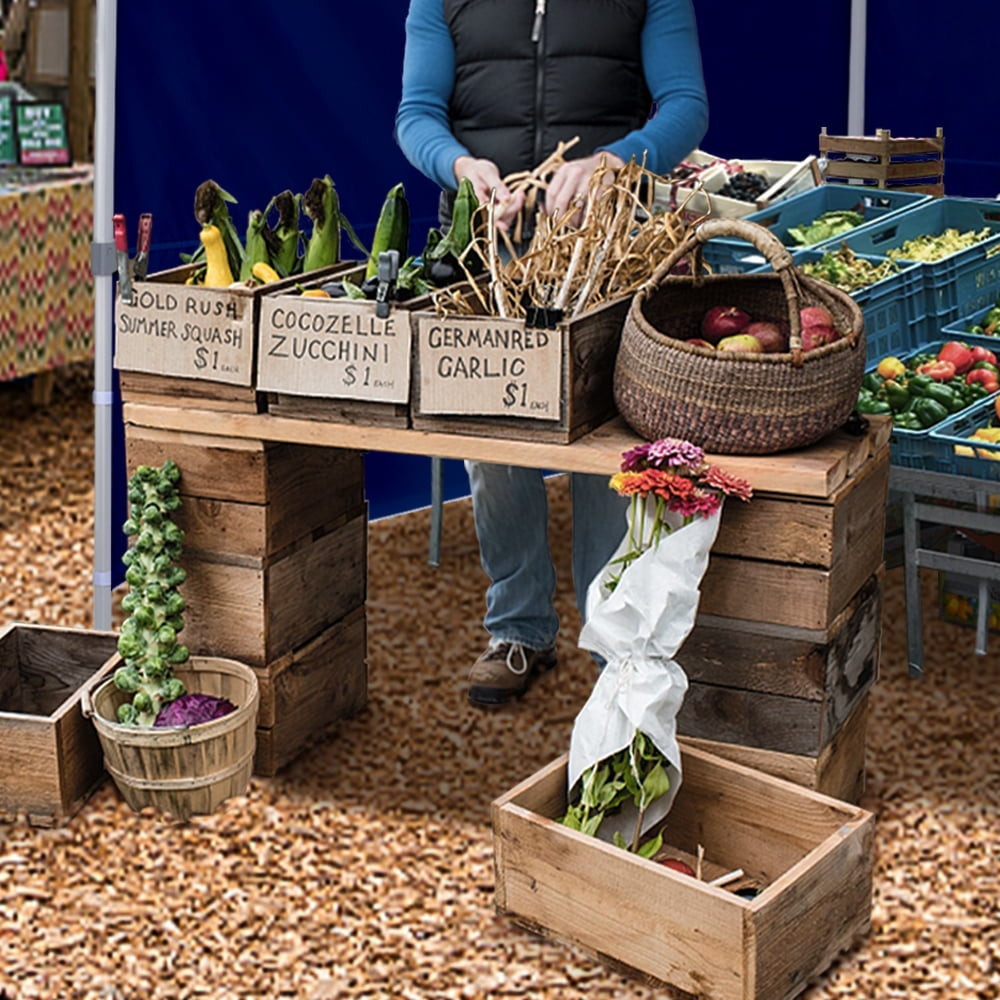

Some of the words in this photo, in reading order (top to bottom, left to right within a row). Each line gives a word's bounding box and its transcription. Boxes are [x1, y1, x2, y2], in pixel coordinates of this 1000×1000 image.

[185, 296, 237, 319] RUSH
[119, 313, 178, 339] SUMMER
[180, 323, 243, 348] SQUASH
[271, 308, 397, 337] COCOZELLE
[194, 346, 218, 371] $1
[268, 334, 389, 363] ZUCCHINI
[342, 364, 371, 386] $1
[437, 355, 525, 378] GARLIC
[502, 381, 528, 408] $1
